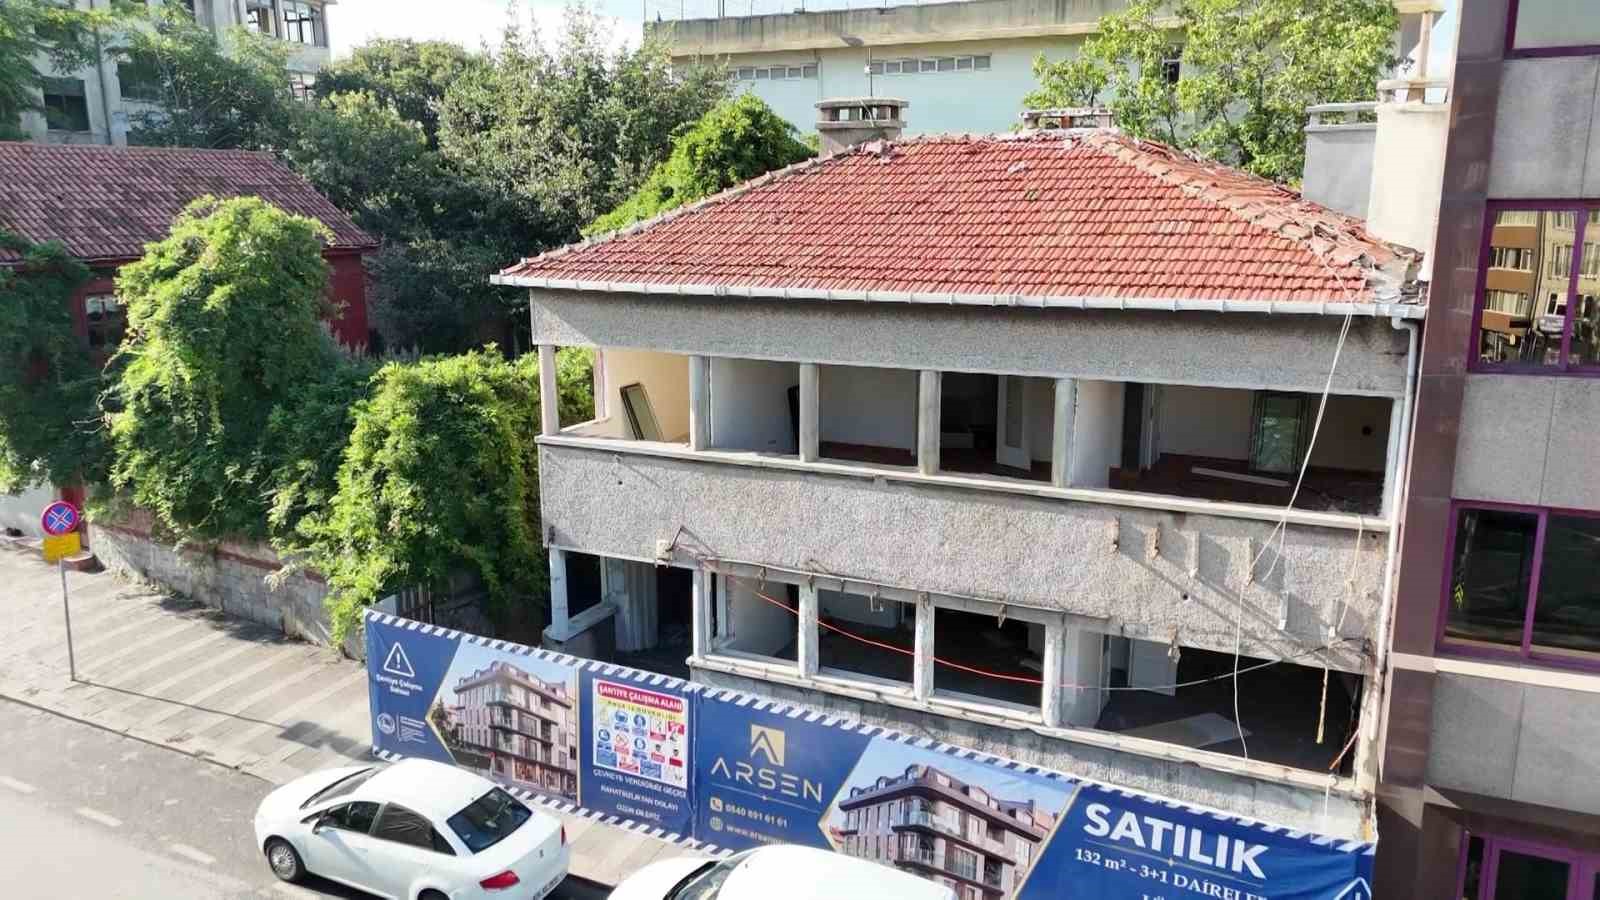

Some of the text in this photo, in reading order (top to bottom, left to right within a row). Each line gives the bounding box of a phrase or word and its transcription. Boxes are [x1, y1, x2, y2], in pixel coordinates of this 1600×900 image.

[711, 757, 822, 803] ARSEN
[1083, 803, 1269, 880] SATILIK
[1075, 848, 1101, 866] 132
[1104, 857, 1126, 871] m²
[1138, 864, 1169, 884] 3+1
